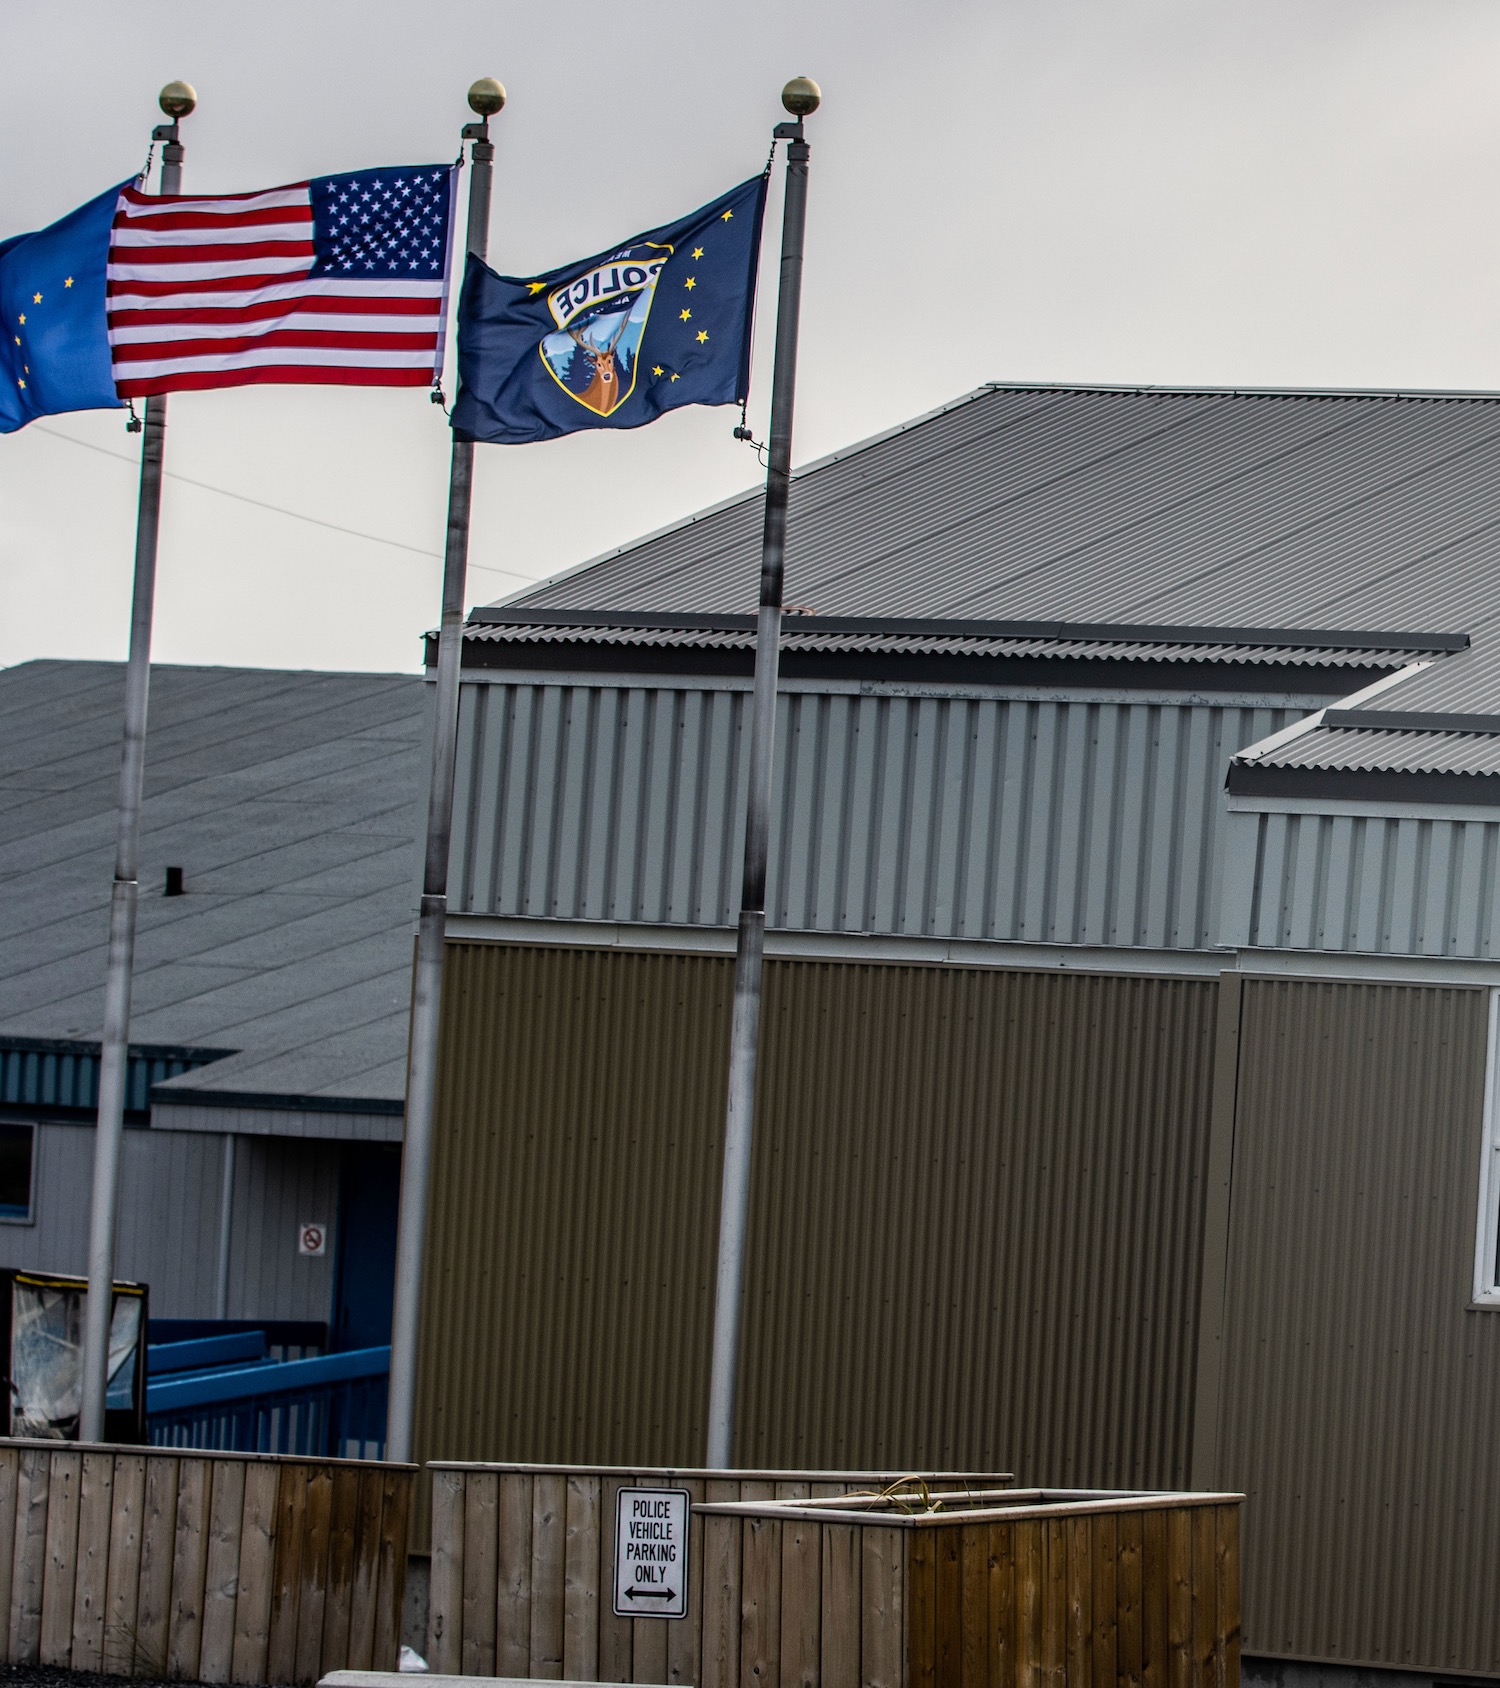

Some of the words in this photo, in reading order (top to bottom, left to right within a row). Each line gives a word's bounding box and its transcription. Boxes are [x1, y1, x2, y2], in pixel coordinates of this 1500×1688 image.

[633, 1500, 670, 1518] POLICE
[629, 1521, 673, 1540] VEHICLE
[626, 1543, 676, 1562] PARKING
[635, 1565, 666, 1583] ONLY
